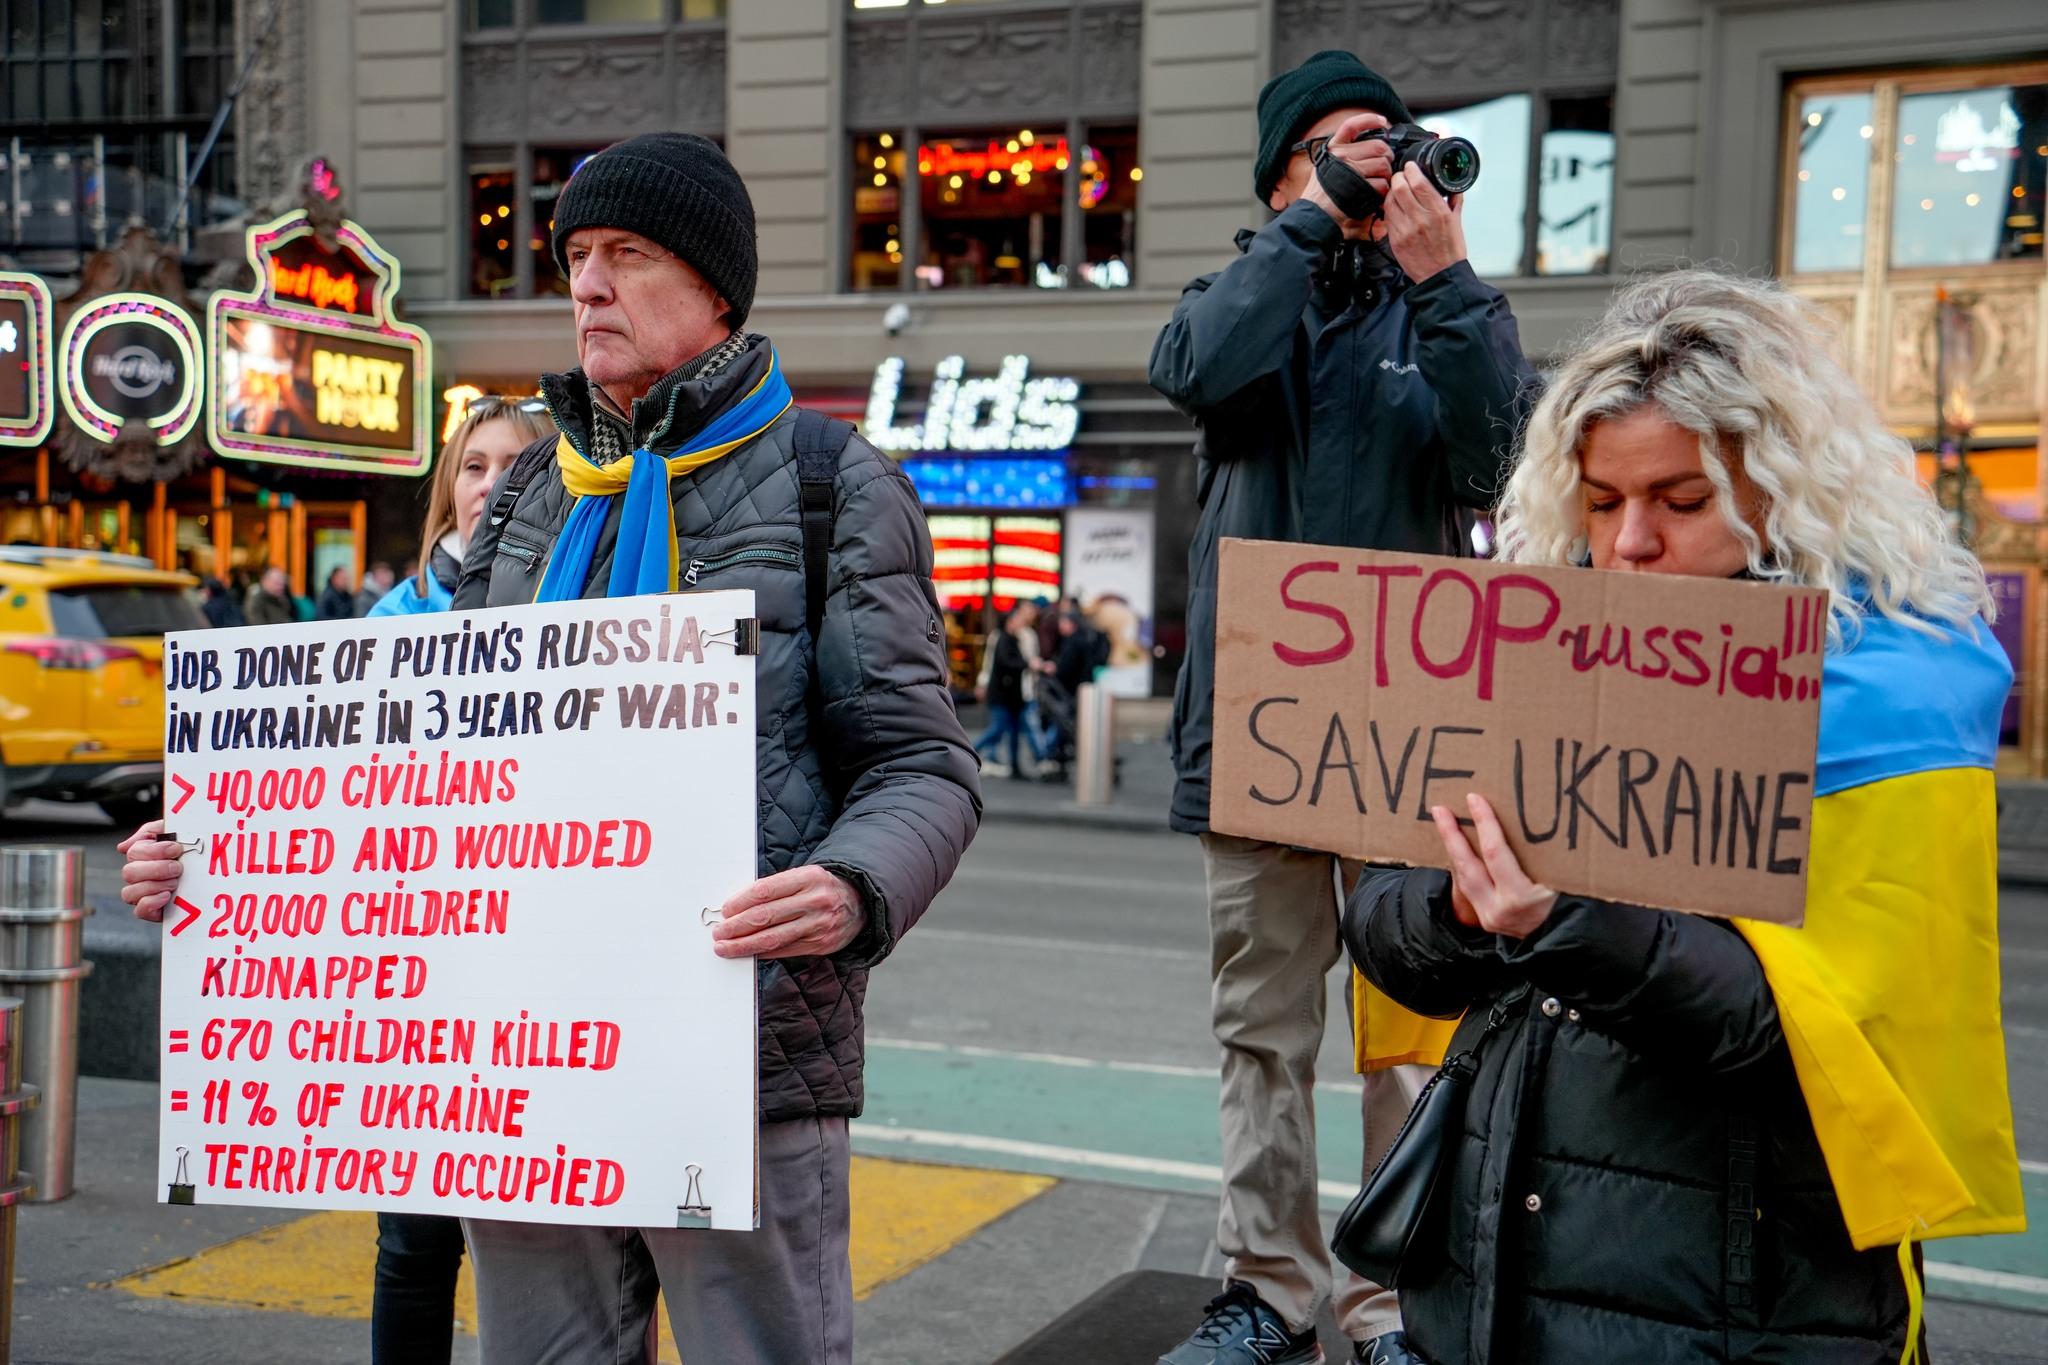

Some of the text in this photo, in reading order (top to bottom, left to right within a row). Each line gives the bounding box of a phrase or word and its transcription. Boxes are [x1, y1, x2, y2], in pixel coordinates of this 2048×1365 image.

[313, 350, 404, 396] PARTY
[316, 387, 399, 432] HOUR
[865, 355, 1079, 451] Lids
[1273, 561, 1560, 700] STOP
[233, 642, 325, 690] DONE
[333, 638, 377, 683] OF
[424, 690, 449, 740] 3
[458, 691, 543, 738] YEAR
[554, 688, 604, 731] OF
[618, 681, 740, 730] WAR:
[207, 767, 326, 818] 40,000
[1248, 697, 1810, 875] SAVE UKRAINE
[353, 826, 438, 874] AND
[455, 820, 651, 870] WOUNDED
[208, 893, 327, 943] 20,000
[201, 1018, 272, 1062] 670
[297, 1083, 345, 1128] OF
